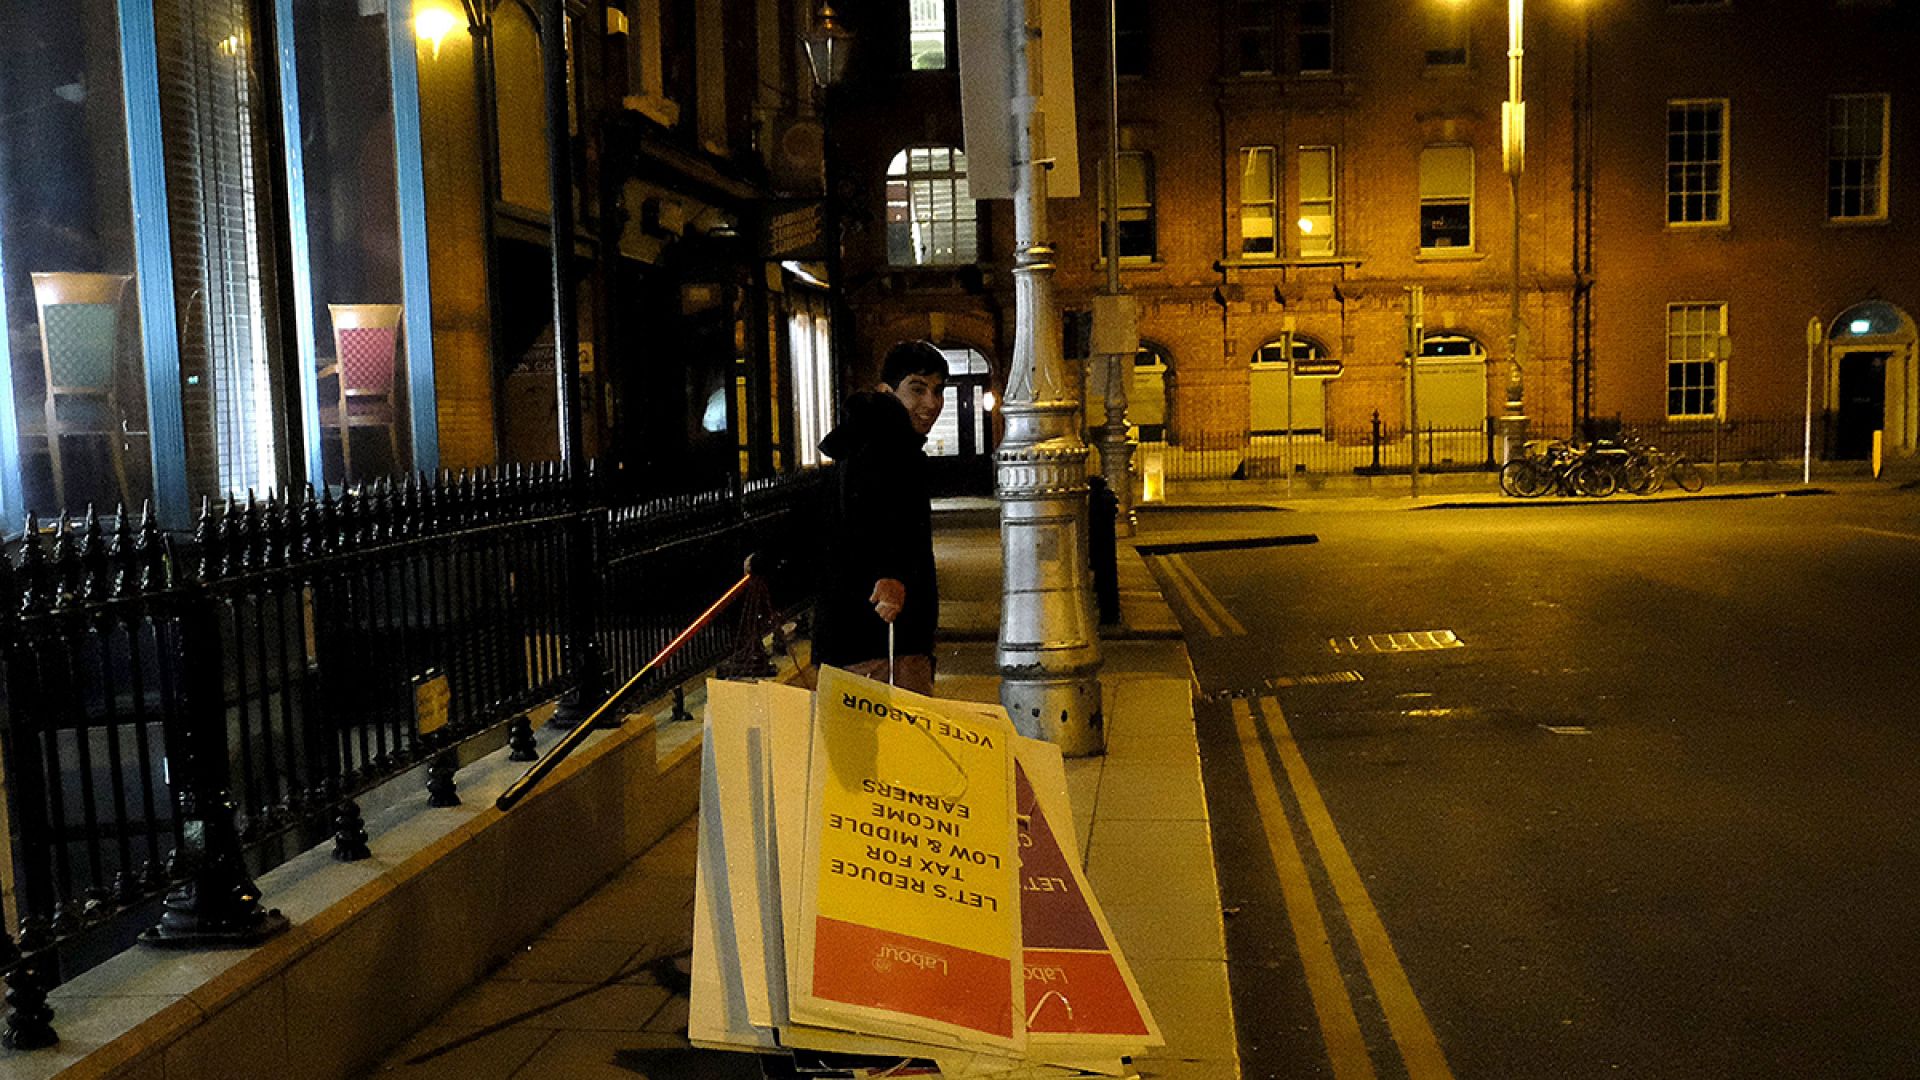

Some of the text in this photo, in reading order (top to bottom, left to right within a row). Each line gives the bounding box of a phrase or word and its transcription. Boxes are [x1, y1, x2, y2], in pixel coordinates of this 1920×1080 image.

[842, 693, 993, 749] VOTE LABOUR
[863, 778, 970, 819] EARNERS
[871, 802, 959, 837] INCOME
[829, 813, 1000, 869] LOW & MIDDLE
[866, 845, 964, 882] TAX FOR
[831, 858, 997, 912] LET'S REDUCE
[1023, 876, 1068, 892] LET'
[877, 946, 948, 976] Labour
[1023, 966, 1068, 984] Labo
